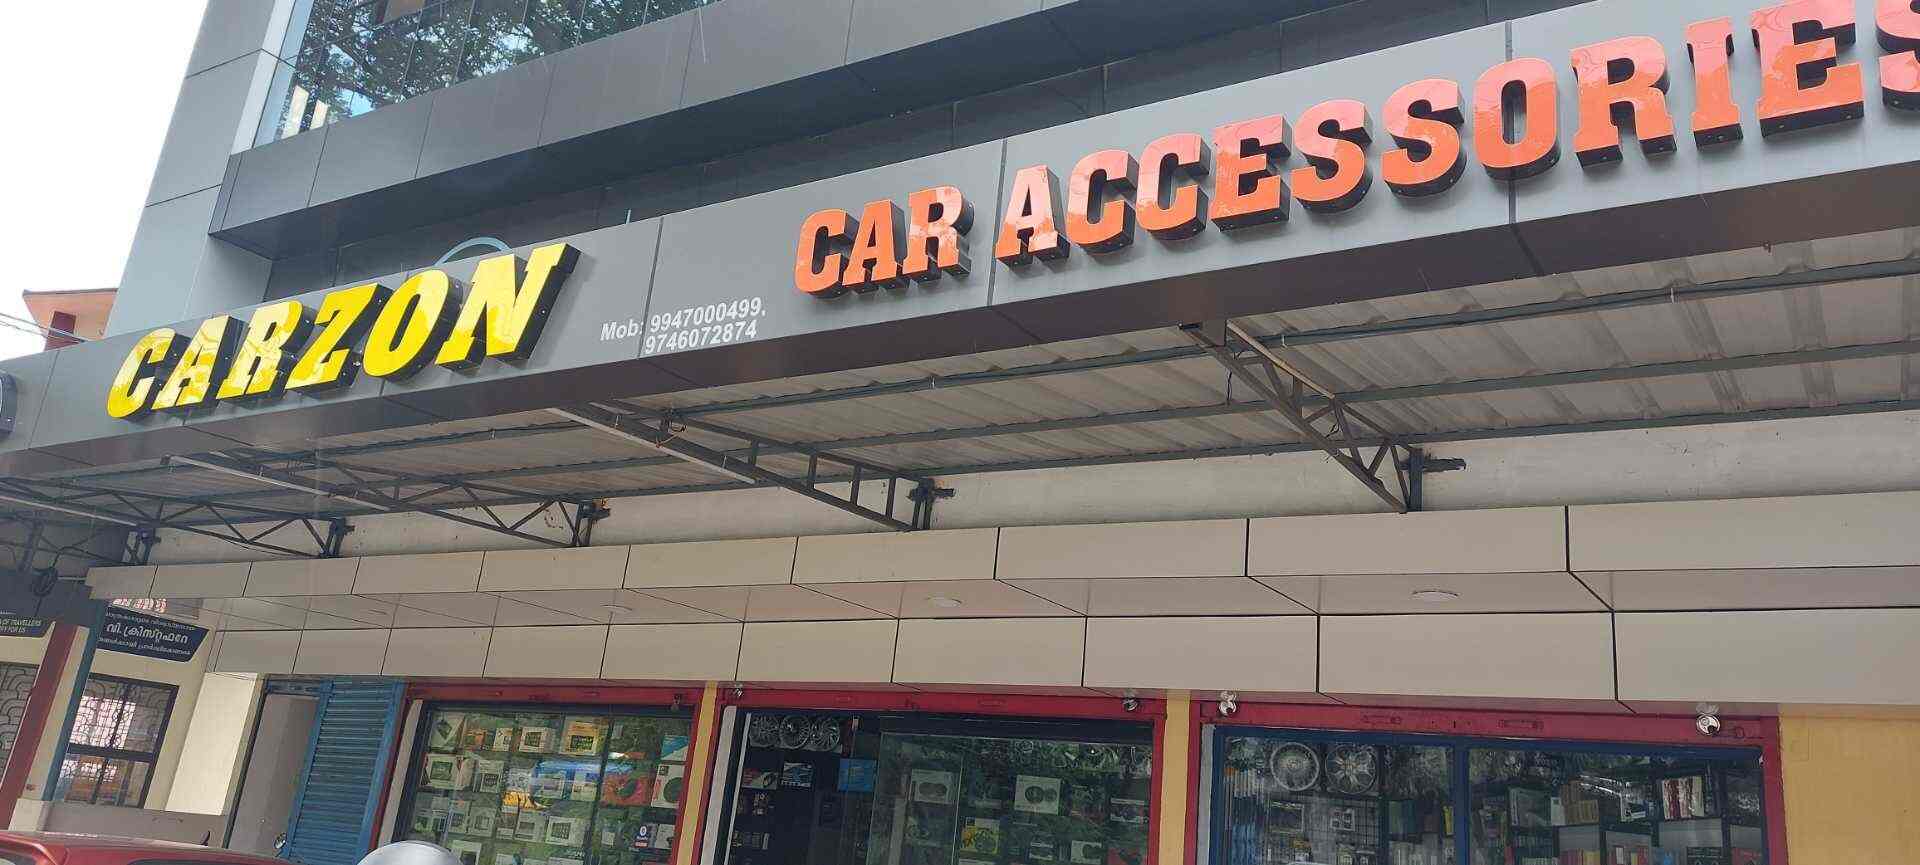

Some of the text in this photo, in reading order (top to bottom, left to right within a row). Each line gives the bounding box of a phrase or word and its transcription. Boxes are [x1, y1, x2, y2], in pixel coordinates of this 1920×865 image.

[794, 186, 970, 296] CAR
[106, 242, 572, 418] CARZON
[645, 320, 757, 354] 9746072874
[650, 297, 766, 333] 9947000499.
